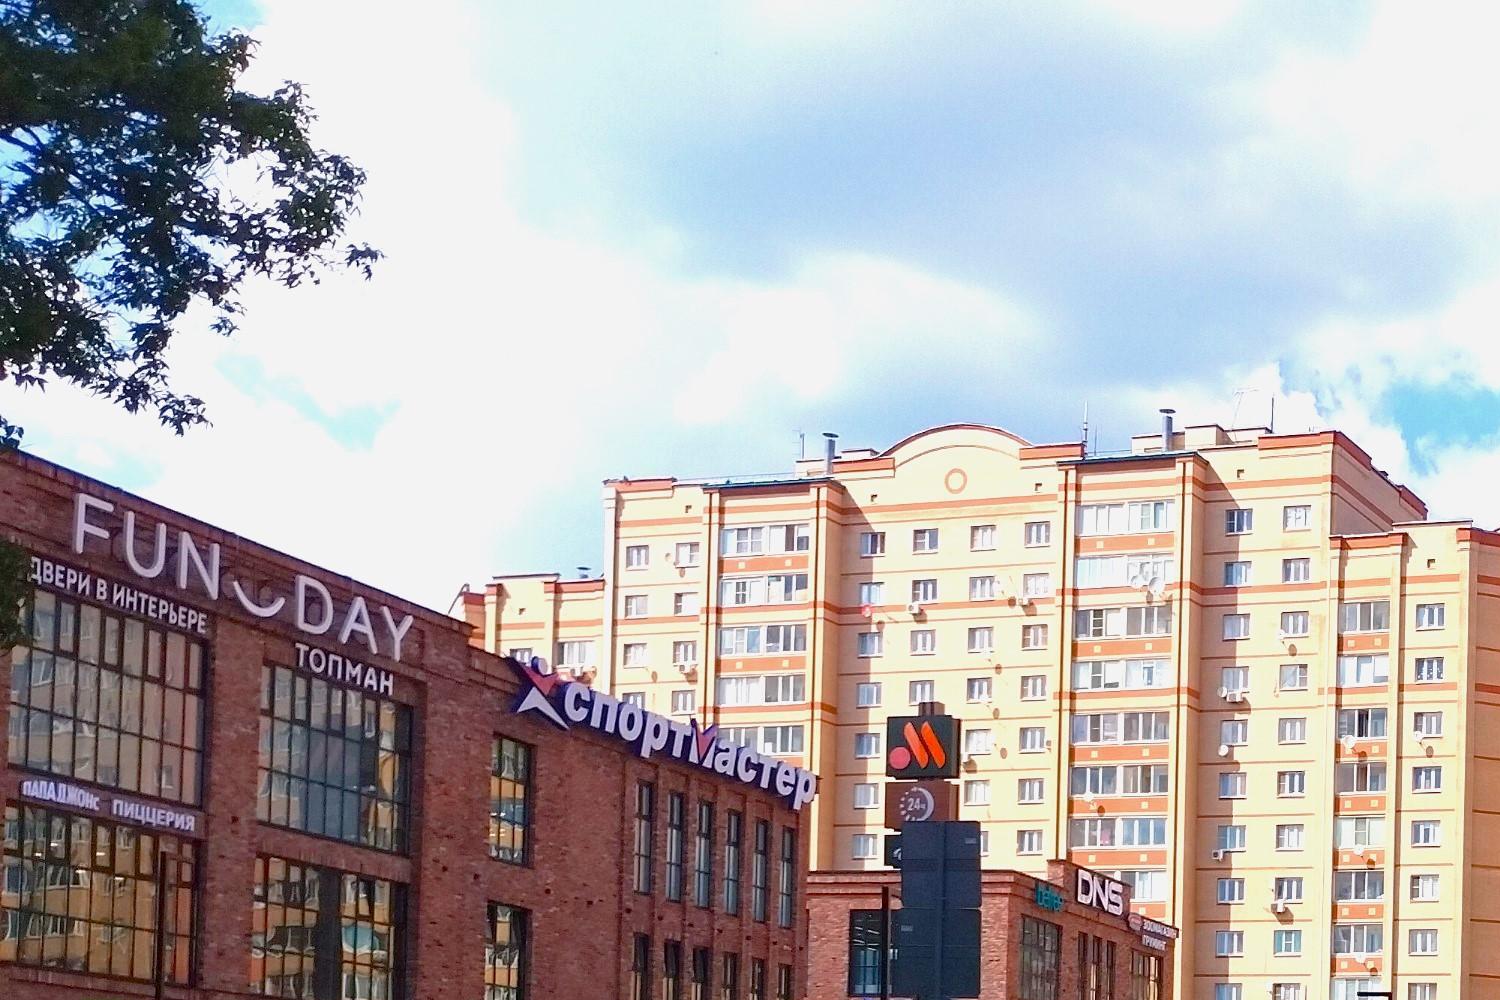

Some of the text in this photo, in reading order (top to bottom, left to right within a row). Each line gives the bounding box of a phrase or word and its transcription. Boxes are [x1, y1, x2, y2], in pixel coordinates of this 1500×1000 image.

[28, 556, 208, 634] ДВЕРИ В ИНТЕРЬЕРЕ
[73, 493, 414, 662] FUN DAY
[295, 642, 394, 696] ТОПМАН
[112, 799, 196, 831] ПИЦЦЕРИЯ
[1077, 869, 1123, 916] DNS
